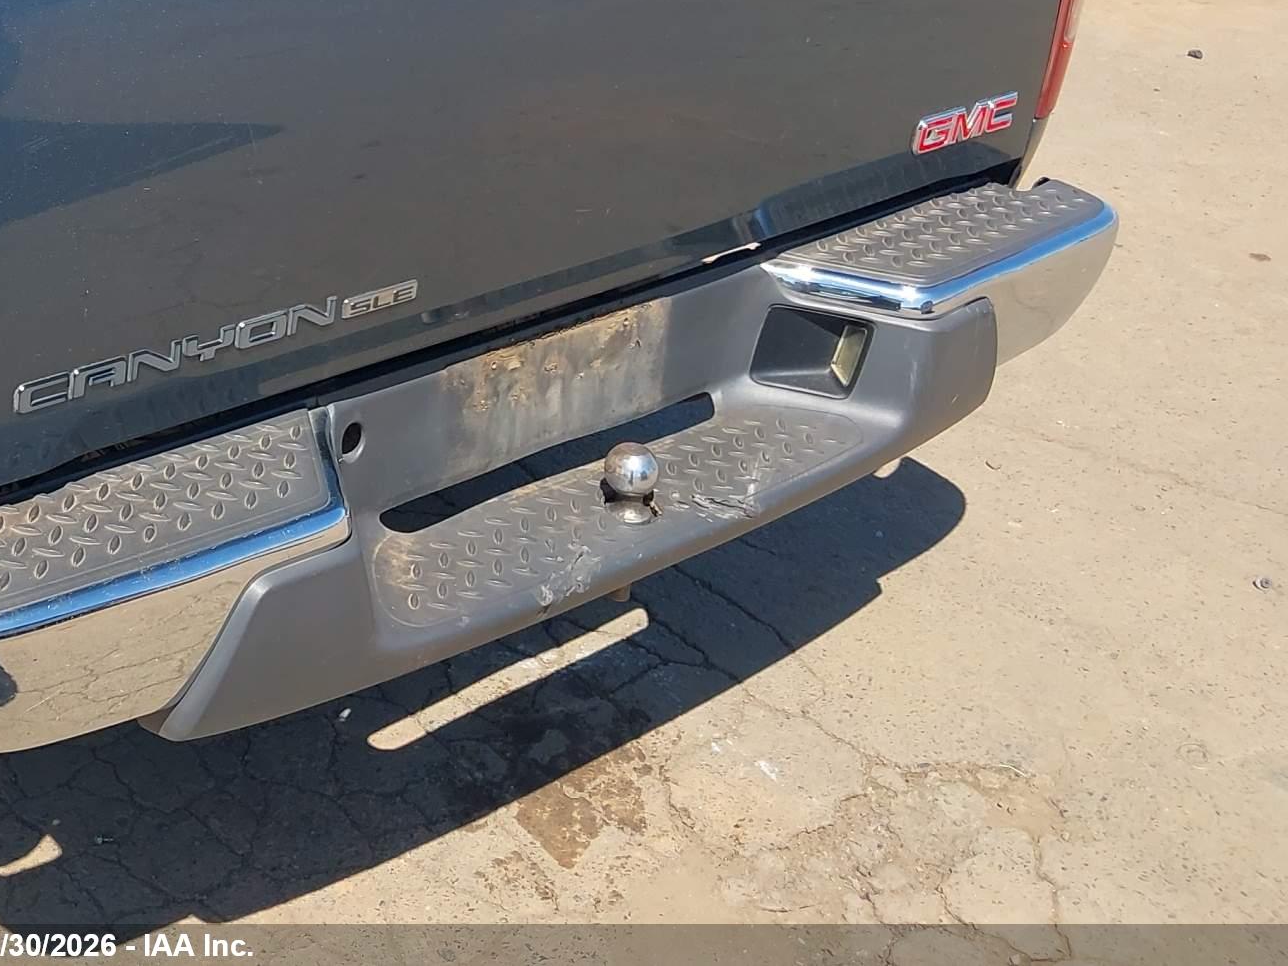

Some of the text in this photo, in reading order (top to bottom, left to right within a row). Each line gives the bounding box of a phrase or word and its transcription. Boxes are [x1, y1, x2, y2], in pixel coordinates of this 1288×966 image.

[912, 91, 1018, 155] GMC
[13, 282, 416, 414] CANYON SLE
